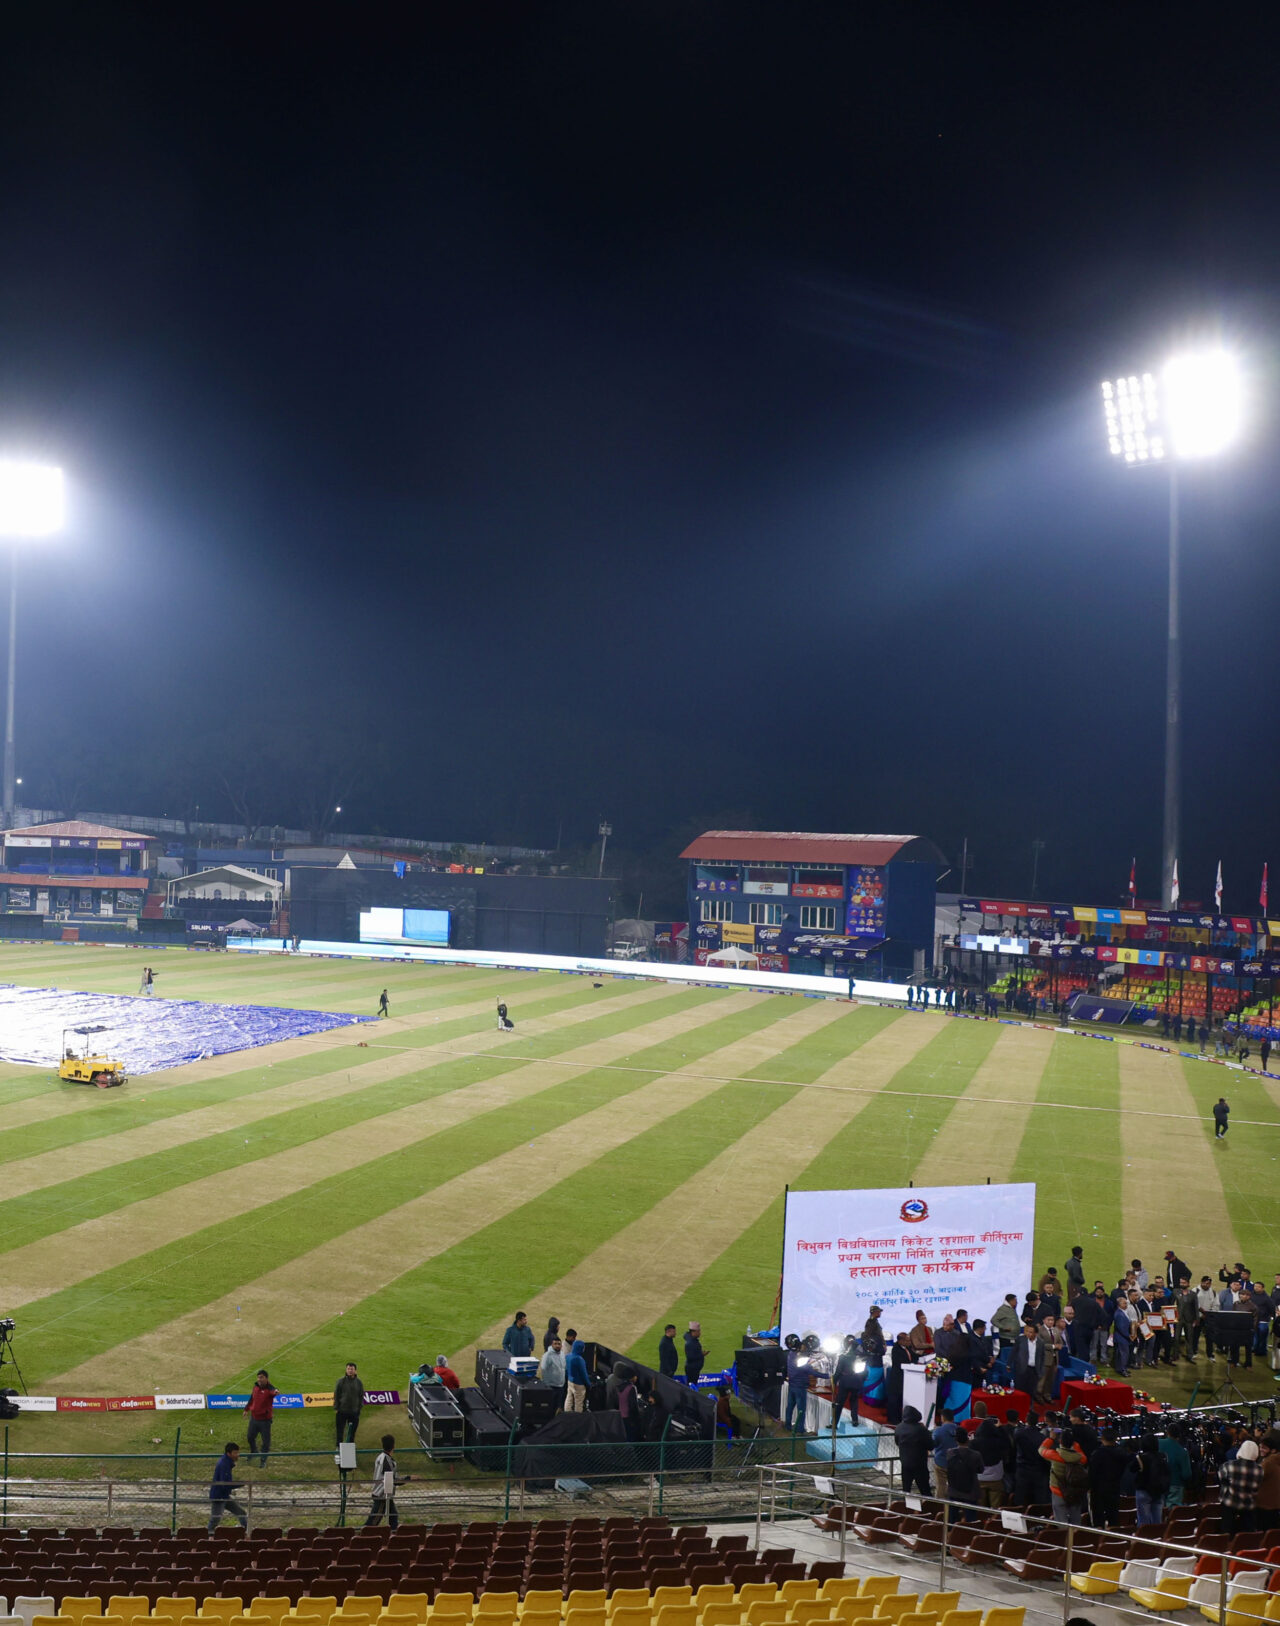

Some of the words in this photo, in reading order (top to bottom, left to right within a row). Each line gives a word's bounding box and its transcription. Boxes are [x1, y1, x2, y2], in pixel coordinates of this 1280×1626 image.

[797, 1240, 832, 1255] त्रिभुवन
[838, 1237, 896, 1249] विश्वविद्यालय
[901, 1235, 934, 1247] क्रिकेट
[980, 1230, 1024, 1245] कीर्तिपुरमा
[838, 1253, 862, 1263] प्रथम
[867, 1251, 901, 1261] चरणमा
[906, 1247, 934, 1260] निर्मित
[849, 1264, 918, 1279] हस्तान्तरण
[922, 1258, 976, 1275] कार्यक्रम
[363, 1391, 394, 1403] Ncell
